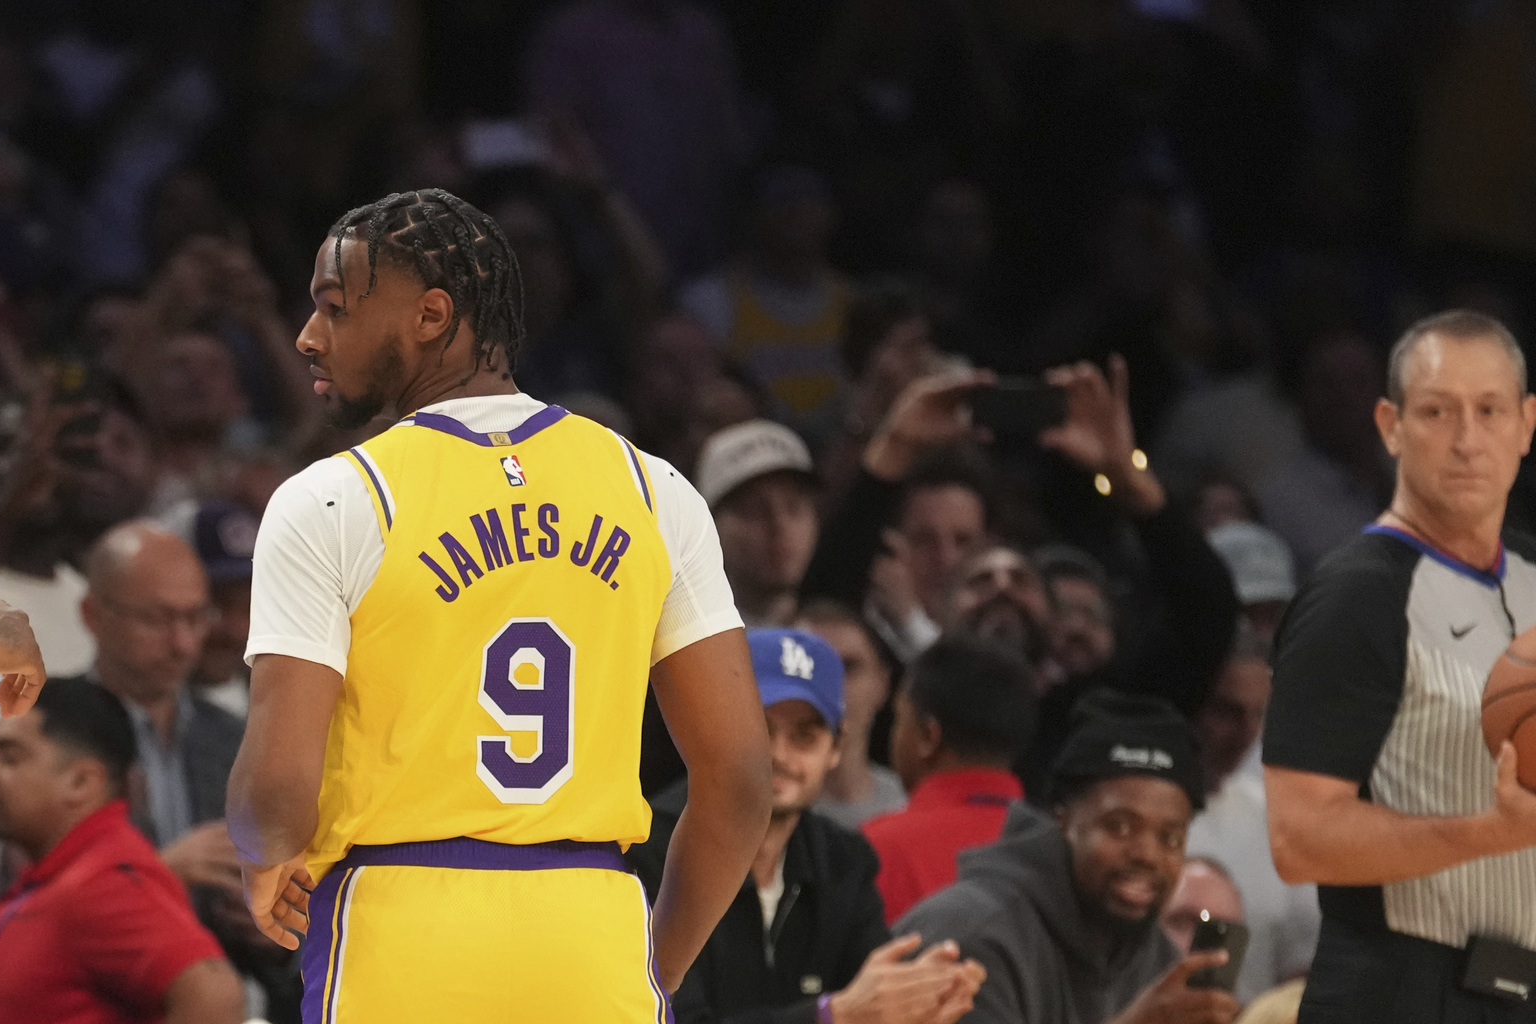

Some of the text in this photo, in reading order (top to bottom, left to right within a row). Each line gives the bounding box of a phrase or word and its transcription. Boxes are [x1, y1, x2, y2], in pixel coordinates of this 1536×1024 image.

[417, 502, 631, 603] JAMES JR.
[475, 616, 577, 805] 9
